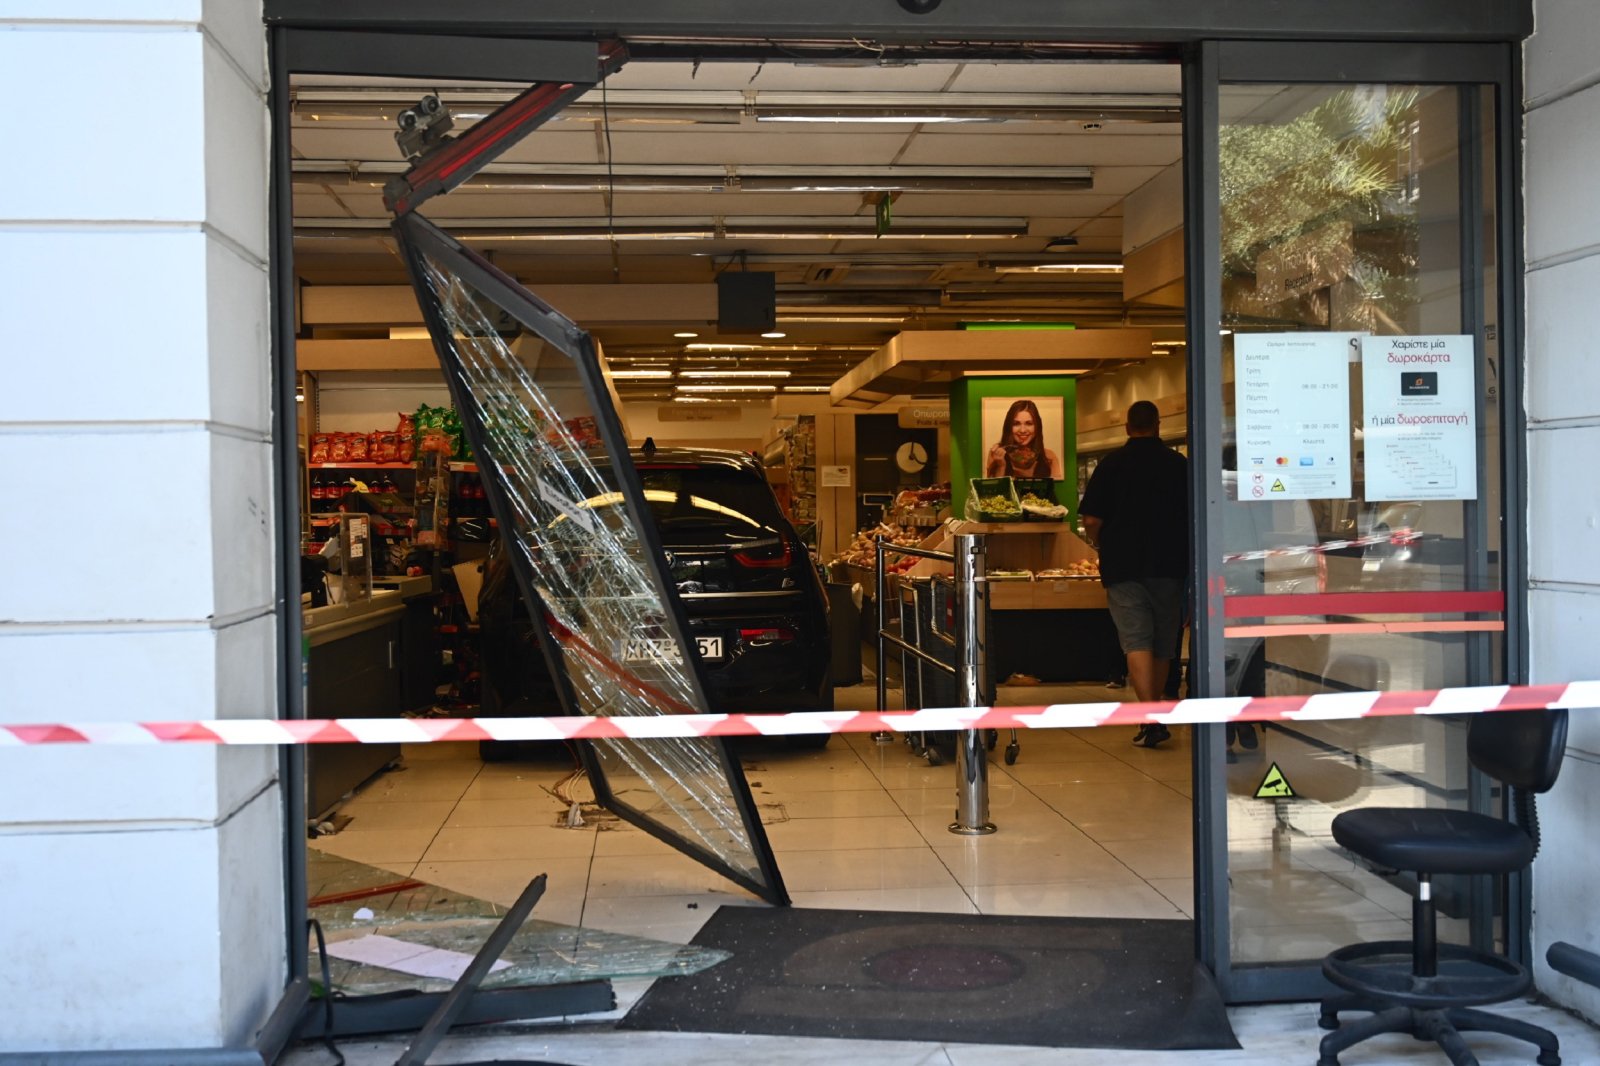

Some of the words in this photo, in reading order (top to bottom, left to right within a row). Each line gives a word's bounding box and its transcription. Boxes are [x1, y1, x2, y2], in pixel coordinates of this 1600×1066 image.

[1392, 340, 1429, 350] Χαρίστε
[1431, 339, 1445, 350] μία
[1387, 352, 1451, 364] δωροκάρτα
[1372, 415, 1378, 426] ή
[1380, 414, 1395, 426] μία
[1397, 412, 1468, 426] δωροεπιταγή
